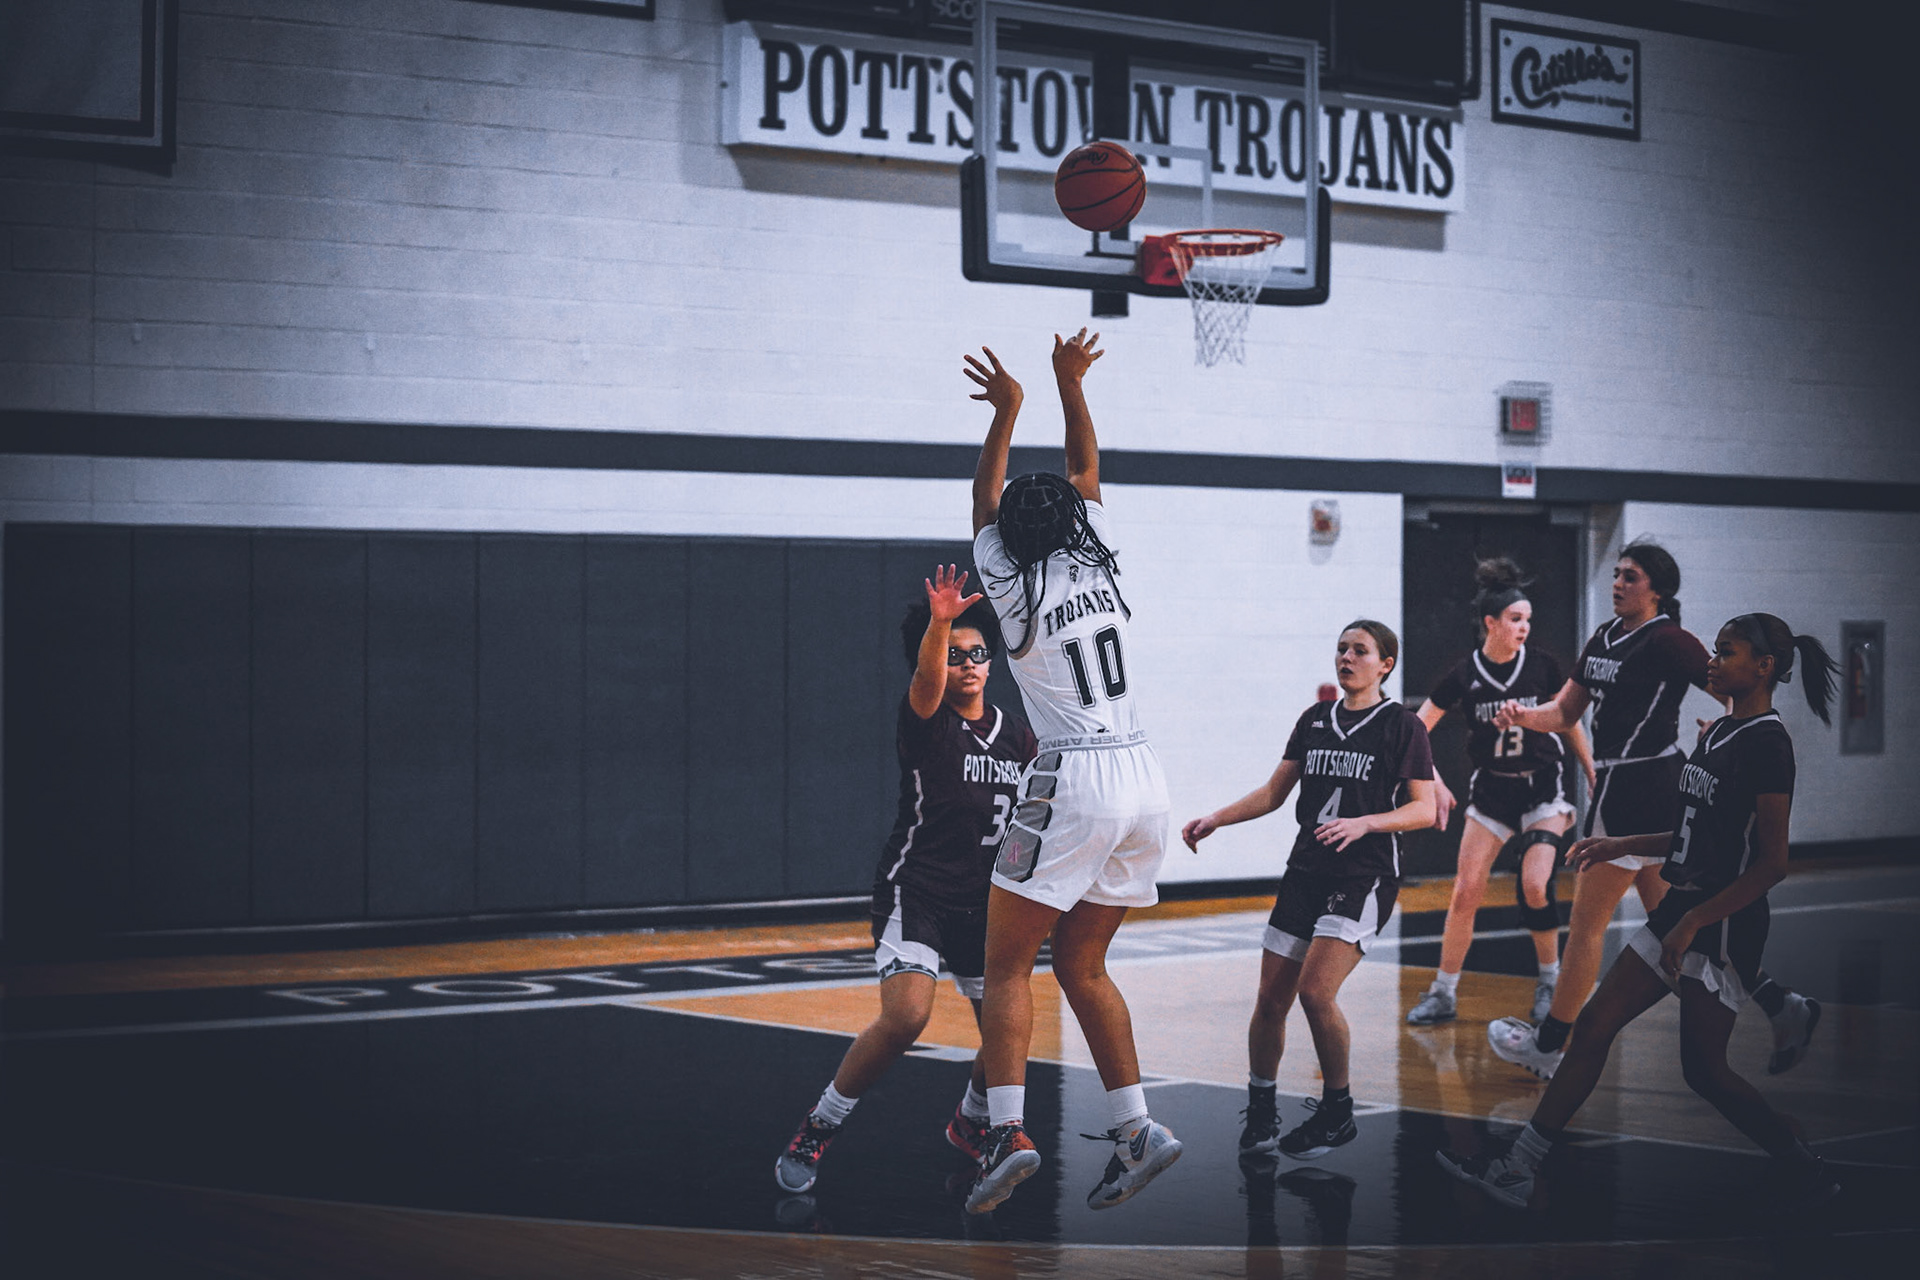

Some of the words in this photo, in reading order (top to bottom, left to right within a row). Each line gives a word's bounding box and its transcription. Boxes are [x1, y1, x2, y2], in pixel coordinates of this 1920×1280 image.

[1195, 89, 1455, 198] TROJANS
[1044, 589, 1116, 639] TROJANS
[1061, 623, 1129, 709] 10
[1494, 726, 1525, 758] 13
[980, 793, 1012, 847] 3
[1316, 786, 1343, 825] 4
[1670, 805, 1698, 866] 5
[265, 953, 878, 1006] POTTS
